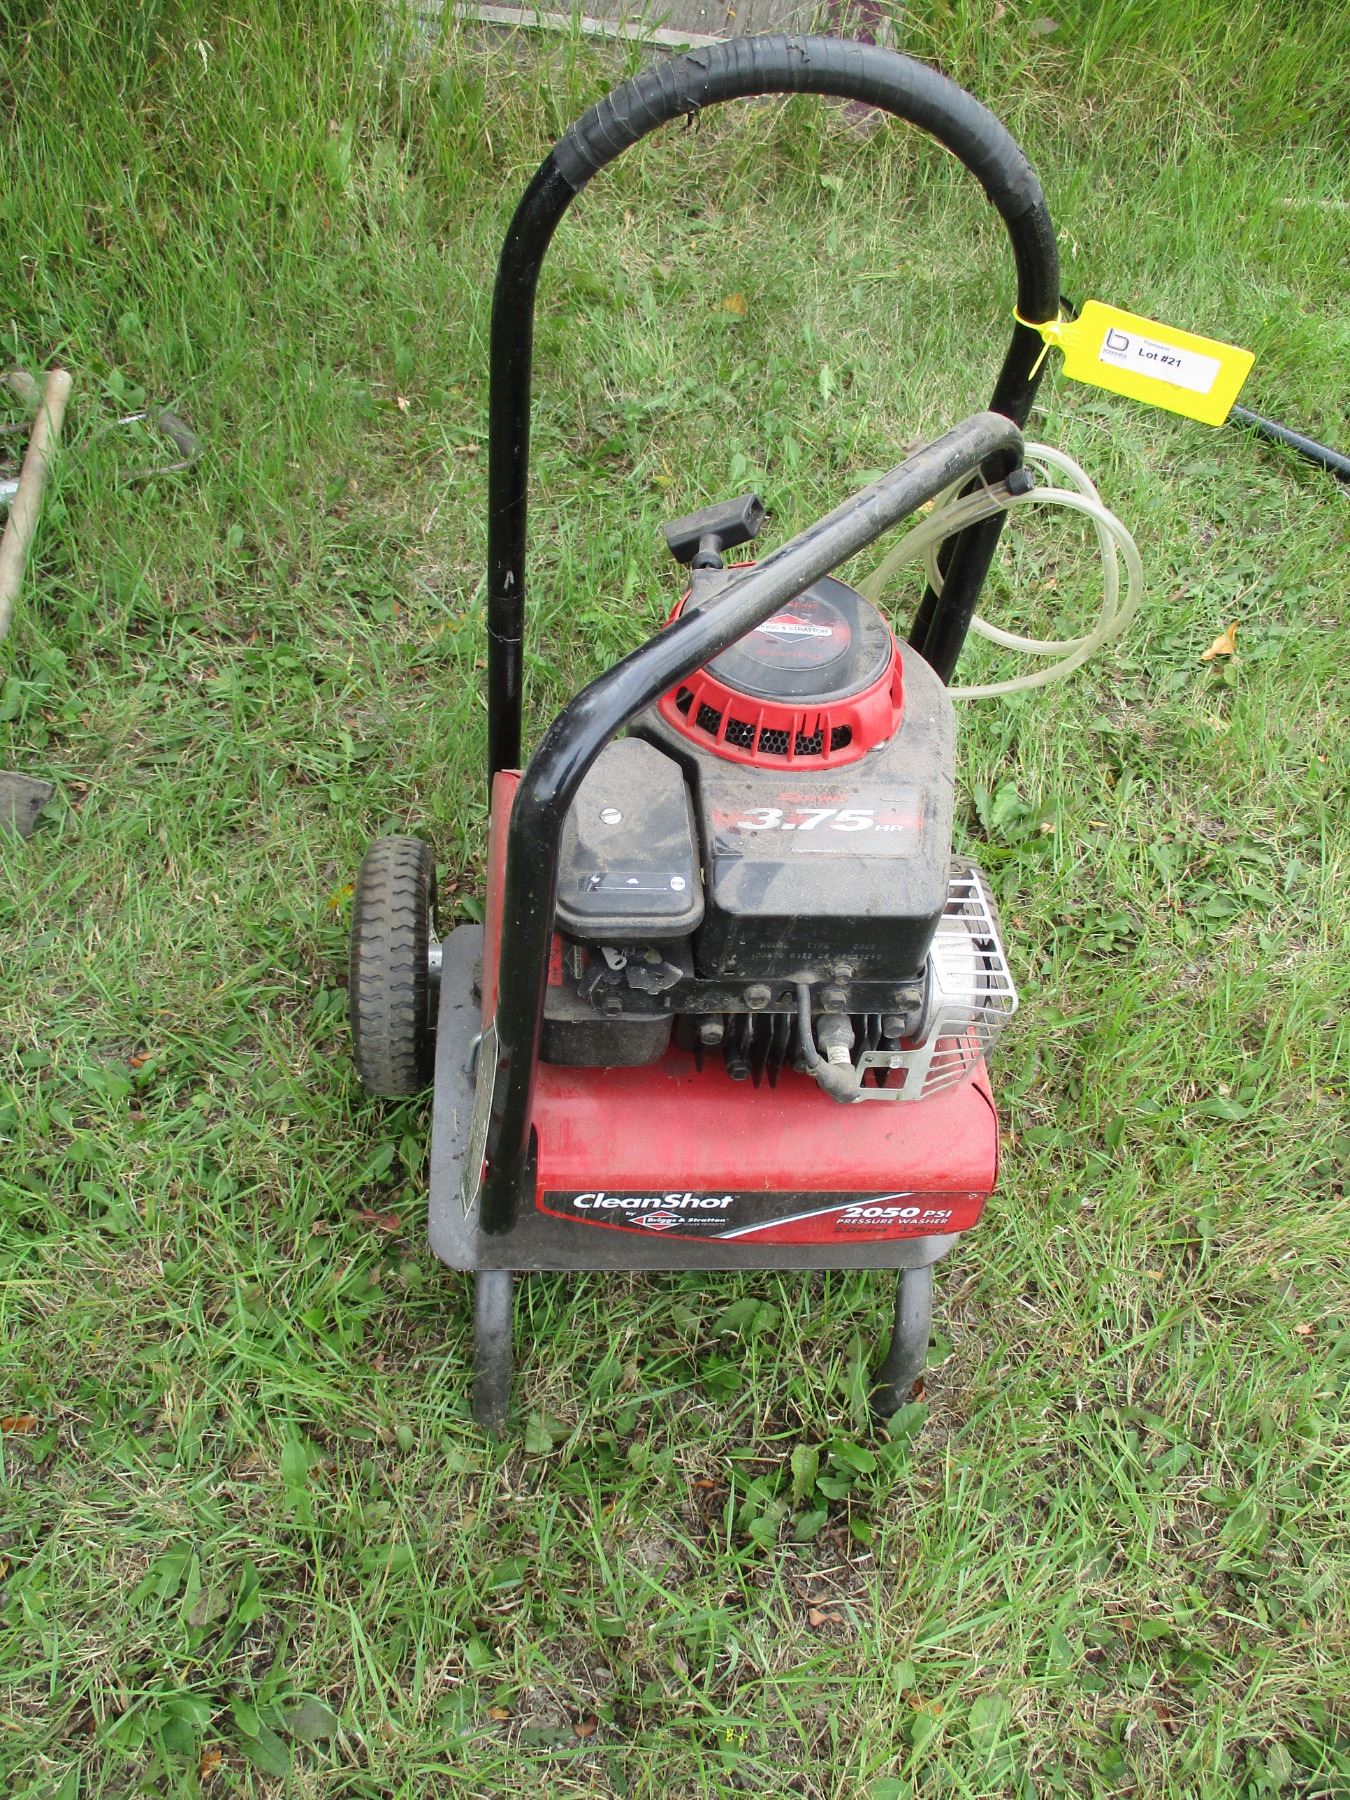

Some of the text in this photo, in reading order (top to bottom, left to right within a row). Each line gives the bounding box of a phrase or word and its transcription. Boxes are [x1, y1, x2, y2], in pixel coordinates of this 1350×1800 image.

[1138, 348, 1158, 361] Lot
[1160, 355, 1182, 367] #21
[789, 626, 829, 634] STRATTON
[736, 807, 875, 832] 3.75
[573, 1192, 734, 1209] CleanShot
[841, 1207, 953, 1218] 2050 PSI
[647, 1217, 677, 1225] Briggs
